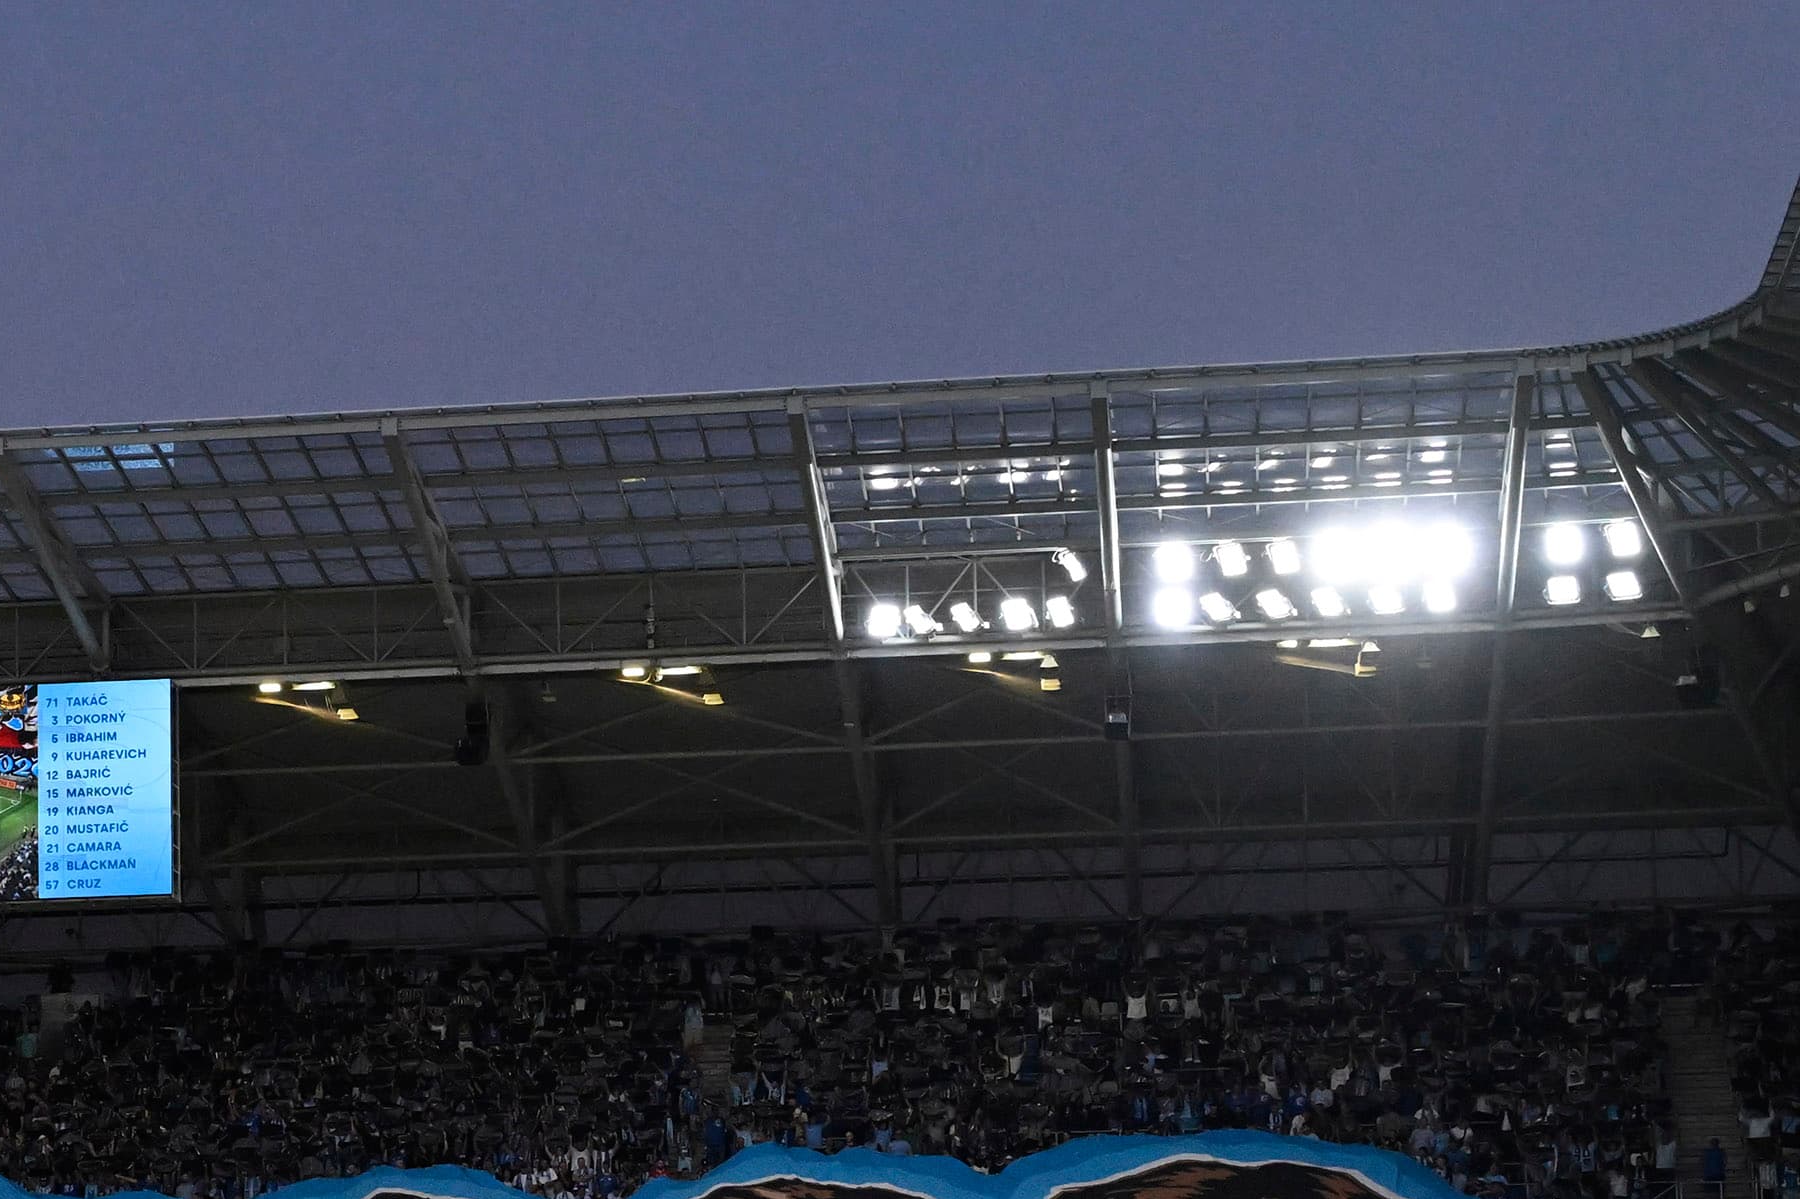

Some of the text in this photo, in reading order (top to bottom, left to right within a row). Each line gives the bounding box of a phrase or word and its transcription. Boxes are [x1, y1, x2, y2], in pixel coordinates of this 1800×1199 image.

[46, 693, 108, 708] 71 TAKÁČ
[52, 710, 126, 725] 3 POKORNÝ
[51, 731, 117, 743] 5 IBRAHIM
[51, 749, 147, 762] 9 KUHAREVICH
[46, 770, 58, 780] 12
[46, 783, 134, 799] 15 MARKOVIĆ
[46, 804, 115, 817] 19 KIANGA
[45, 826, 59, 835] 20
[46, 841, 122, 853] 21 CAMARA
[45, 862, 59, 872] 28
[45, 879, 101, 890] 57 CRUZ
